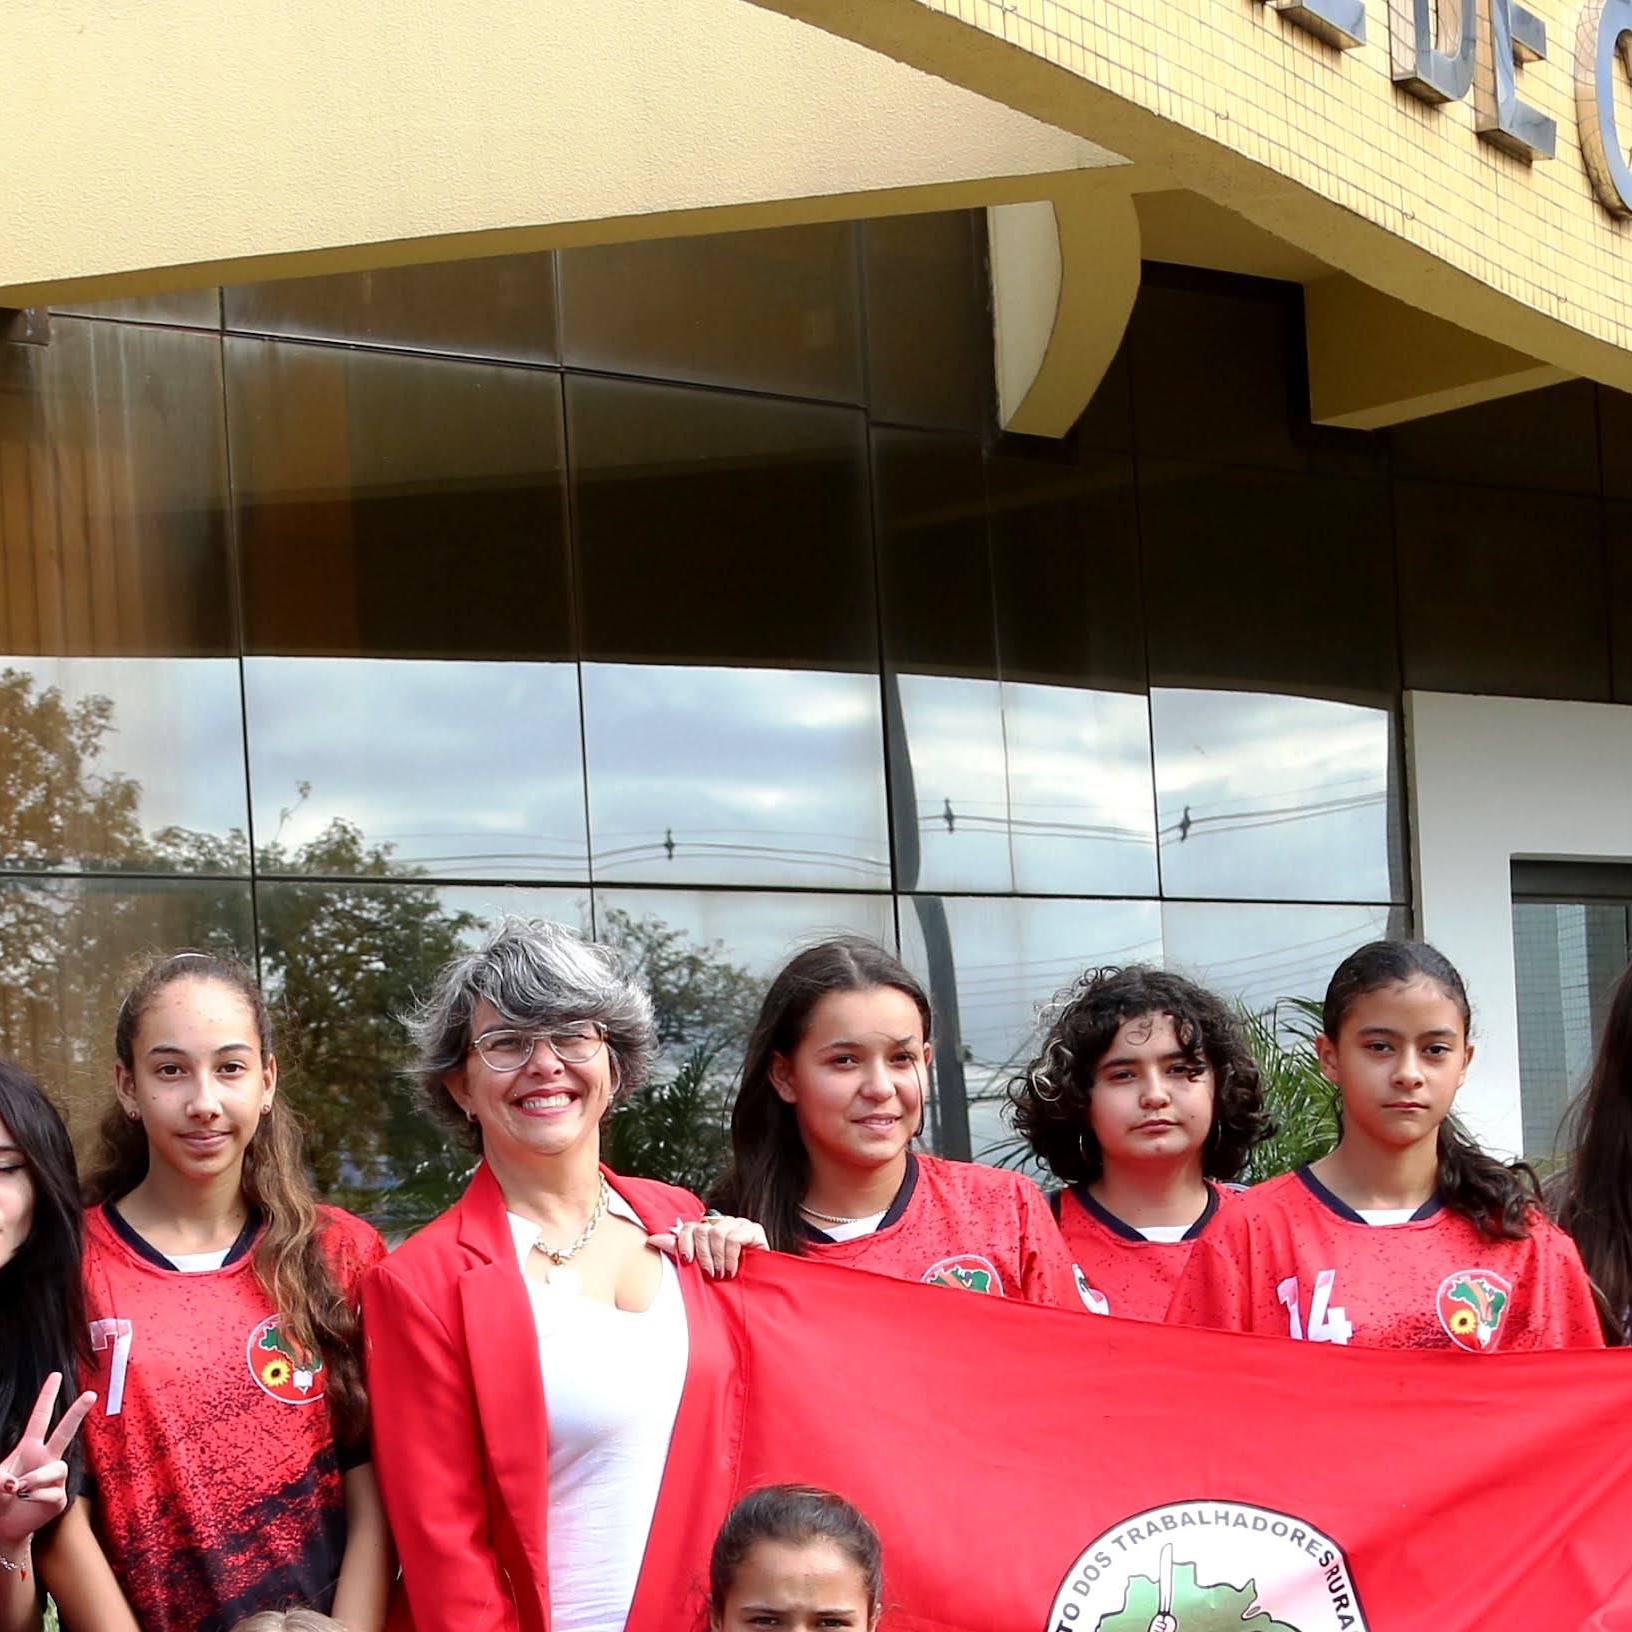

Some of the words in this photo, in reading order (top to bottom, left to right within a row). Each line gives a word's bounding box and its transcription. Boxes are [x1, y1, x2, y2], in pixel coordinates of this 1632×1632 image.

[1276, 1269, 1353, 1345] 14
[89, 1318, 133, 1417] 7
[1073, 1550, 1113, 1598] DOS
[1111, 1509, 1335, 1568] TRABALHADORES
